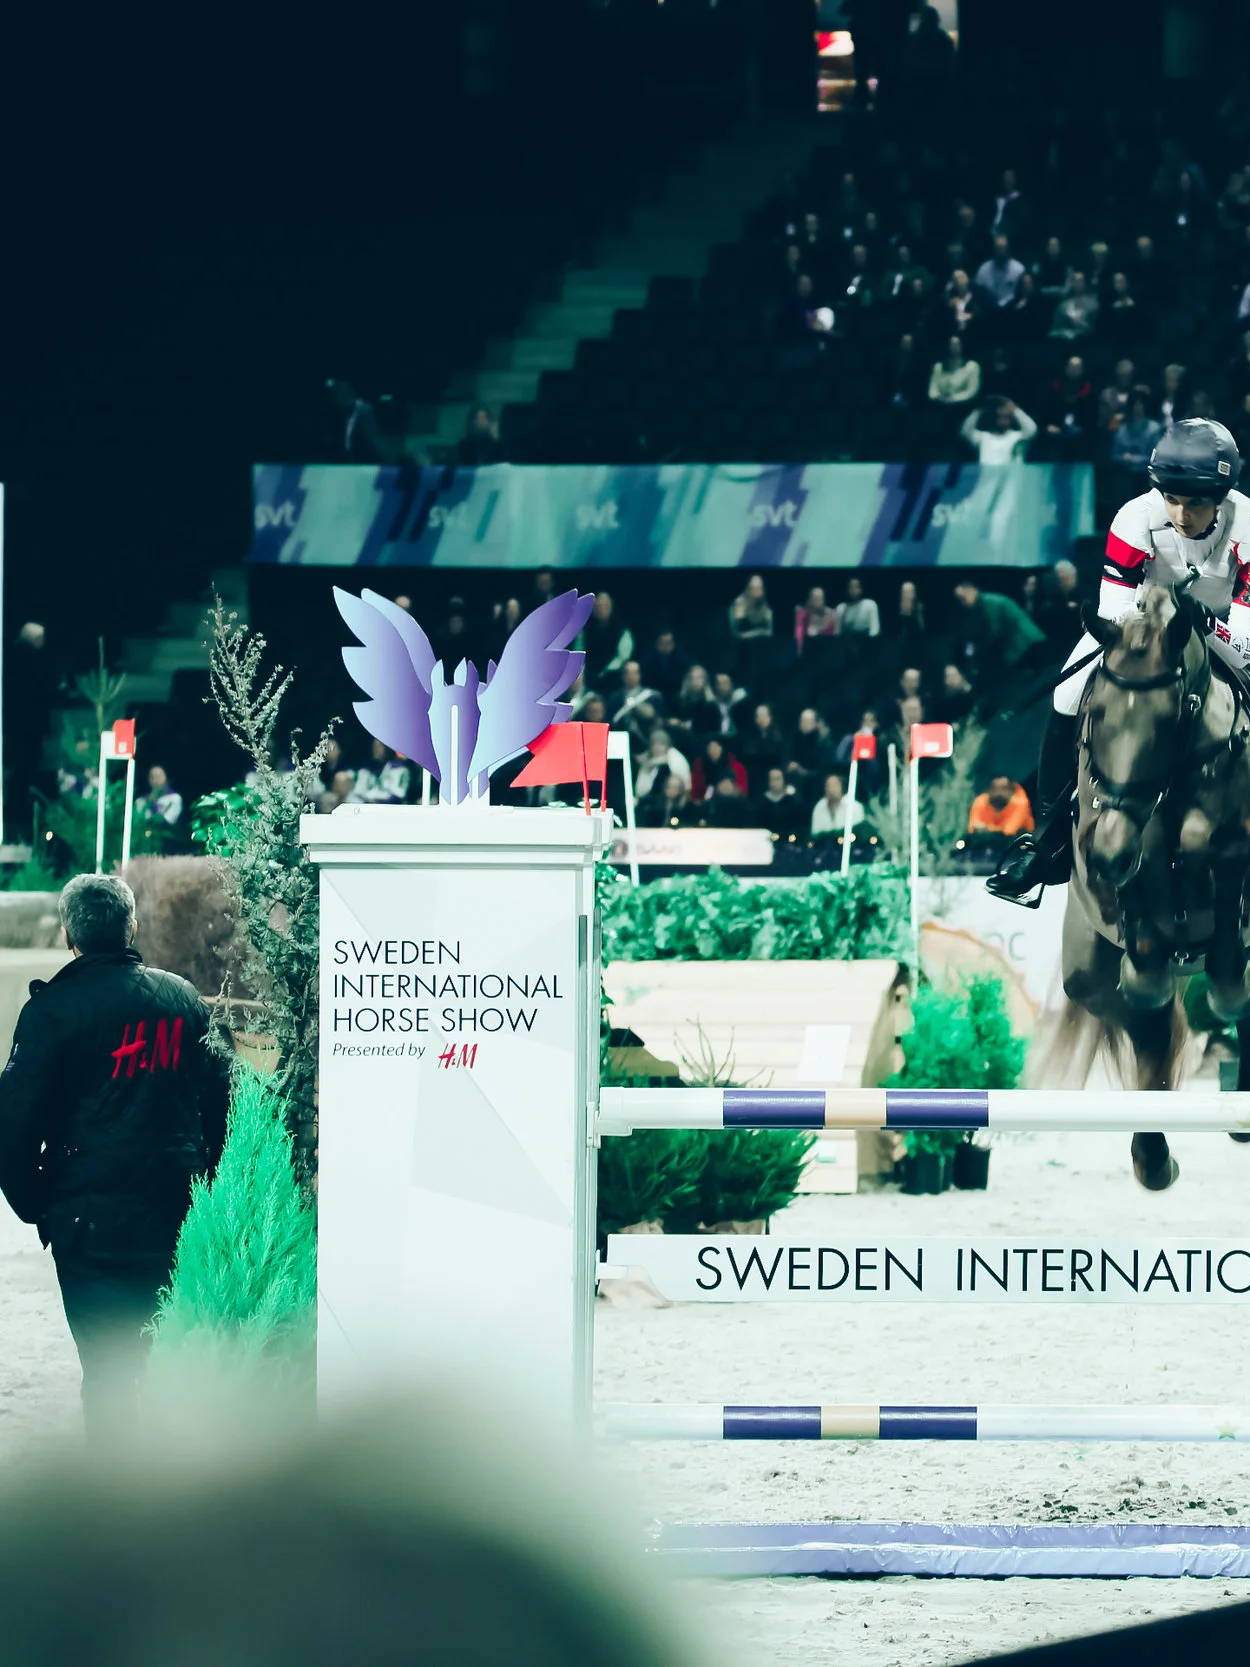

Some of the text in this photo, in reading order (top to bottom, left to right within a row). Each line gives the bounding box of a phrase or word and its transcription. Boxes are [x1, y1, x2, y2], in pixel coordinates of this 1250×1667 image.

[254, 501, 294, 529] svt
[752, 501, 797, 528] svt
[334, 940, 460, 965] SWEDEN
[334, 974, 564, 999] INTERNATIONAL
[334, 1007, 538, 1033] HORSE SHOW
[111, 1016, 183, 1079] H&M
[332, 1042, 479, 1070] Presented by H&M
[695, 1246, 923, 1292] SWEDEN
